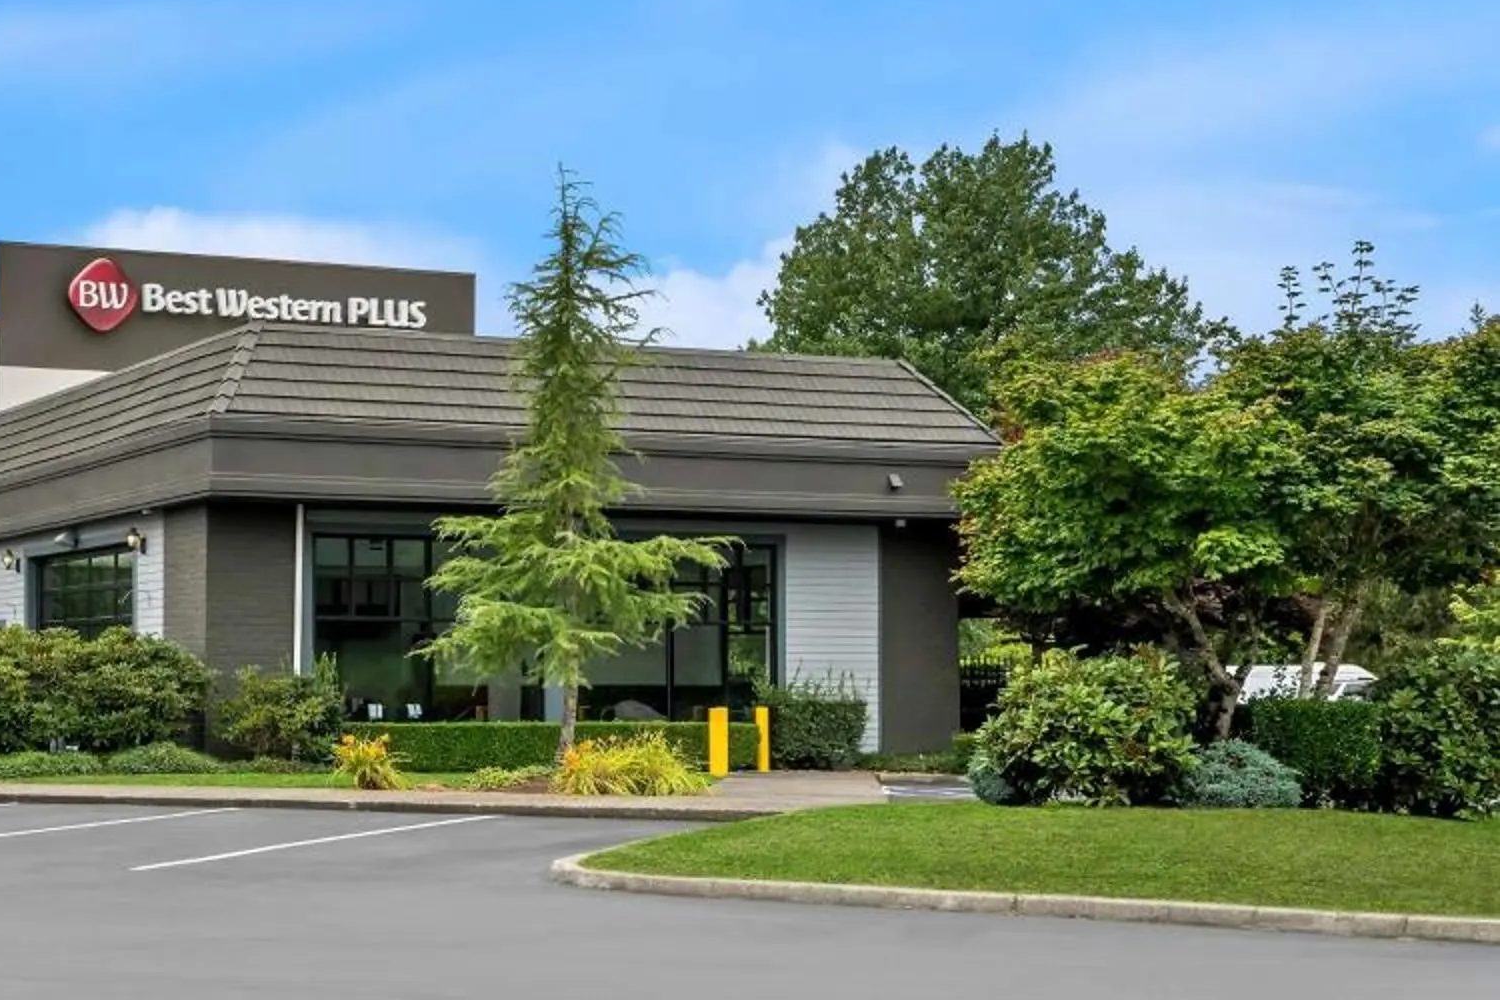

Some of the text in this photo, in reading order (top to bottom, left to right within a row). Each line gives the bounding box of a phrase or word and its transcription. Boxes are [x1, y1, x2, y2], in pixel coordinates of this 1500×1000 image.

[79, 280, 128, 309] BW
[142, 283, 426, 328] Best Western PLUS
